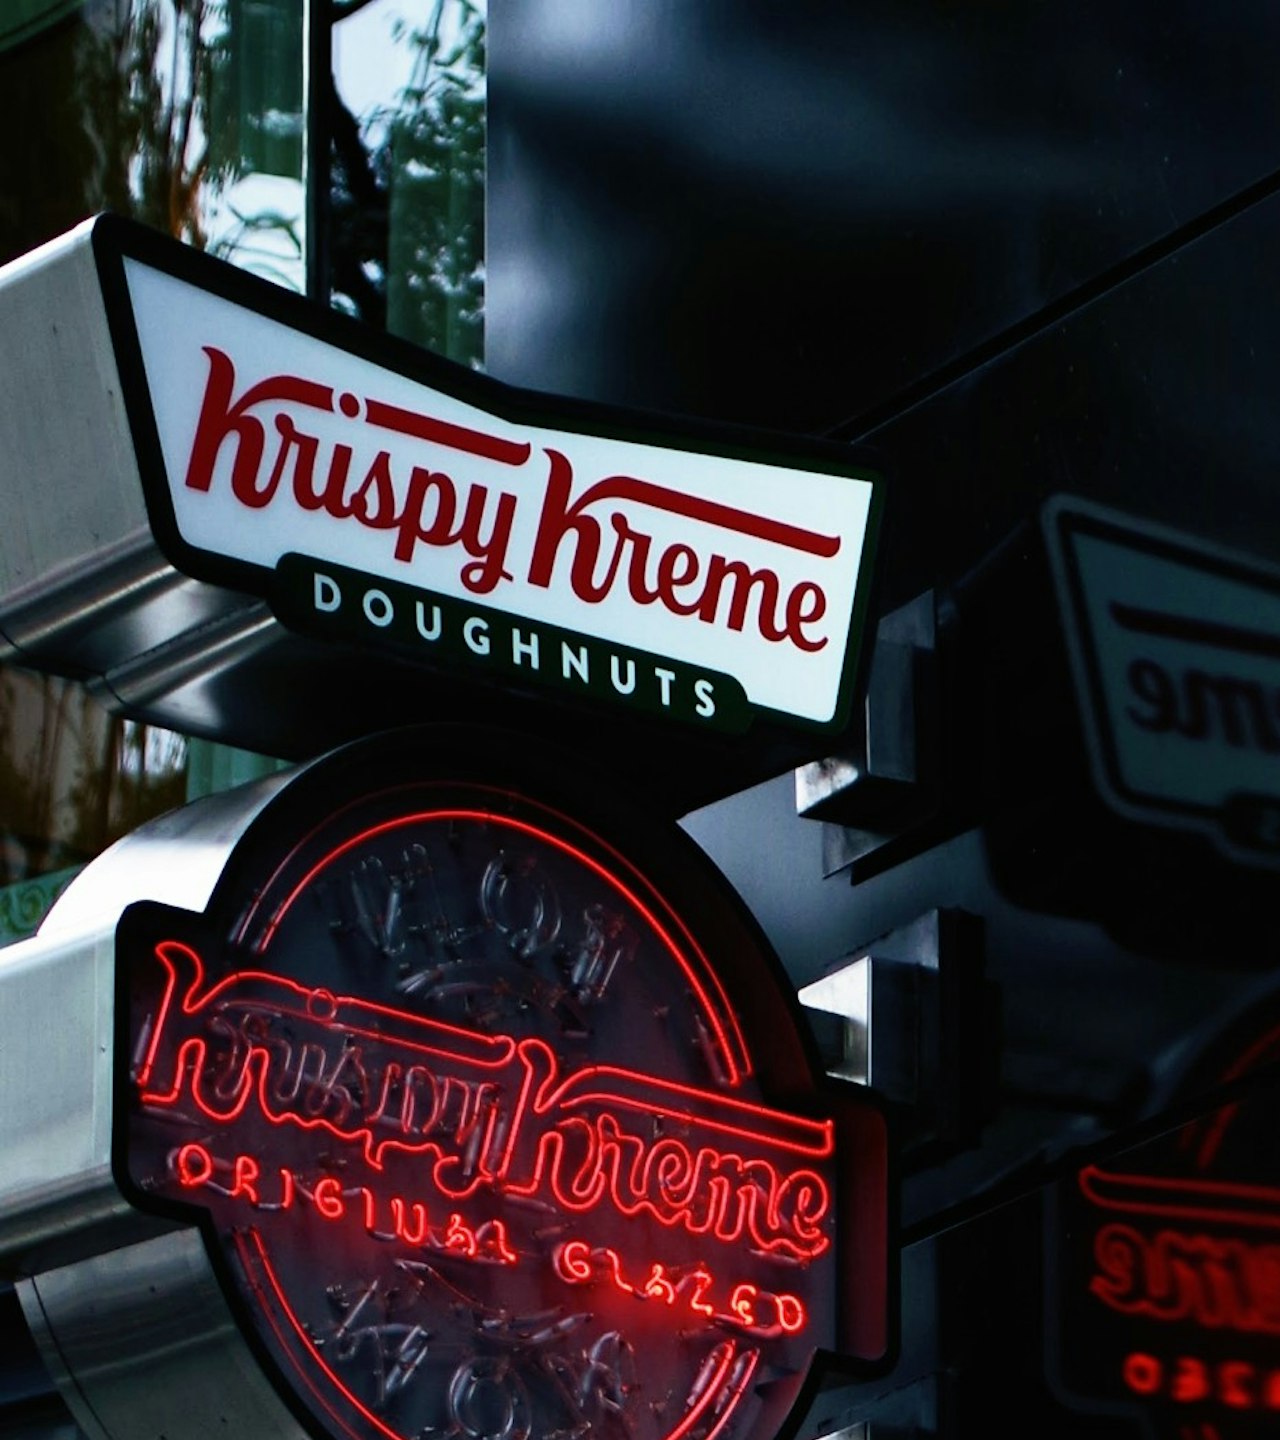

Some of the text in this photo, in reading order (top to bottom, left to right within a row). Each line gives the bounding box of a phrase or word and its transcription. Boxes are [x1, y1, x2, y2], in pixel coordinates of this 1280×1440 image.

[185, 345, 841, 652] Krispy Kreme
[314, 572, 716, 718] DOUGHNUTS
[139, 940, 834, 1258] Krispy Kreme
[168, 1143, 803, 1333] ORIGINAL GLAZED
